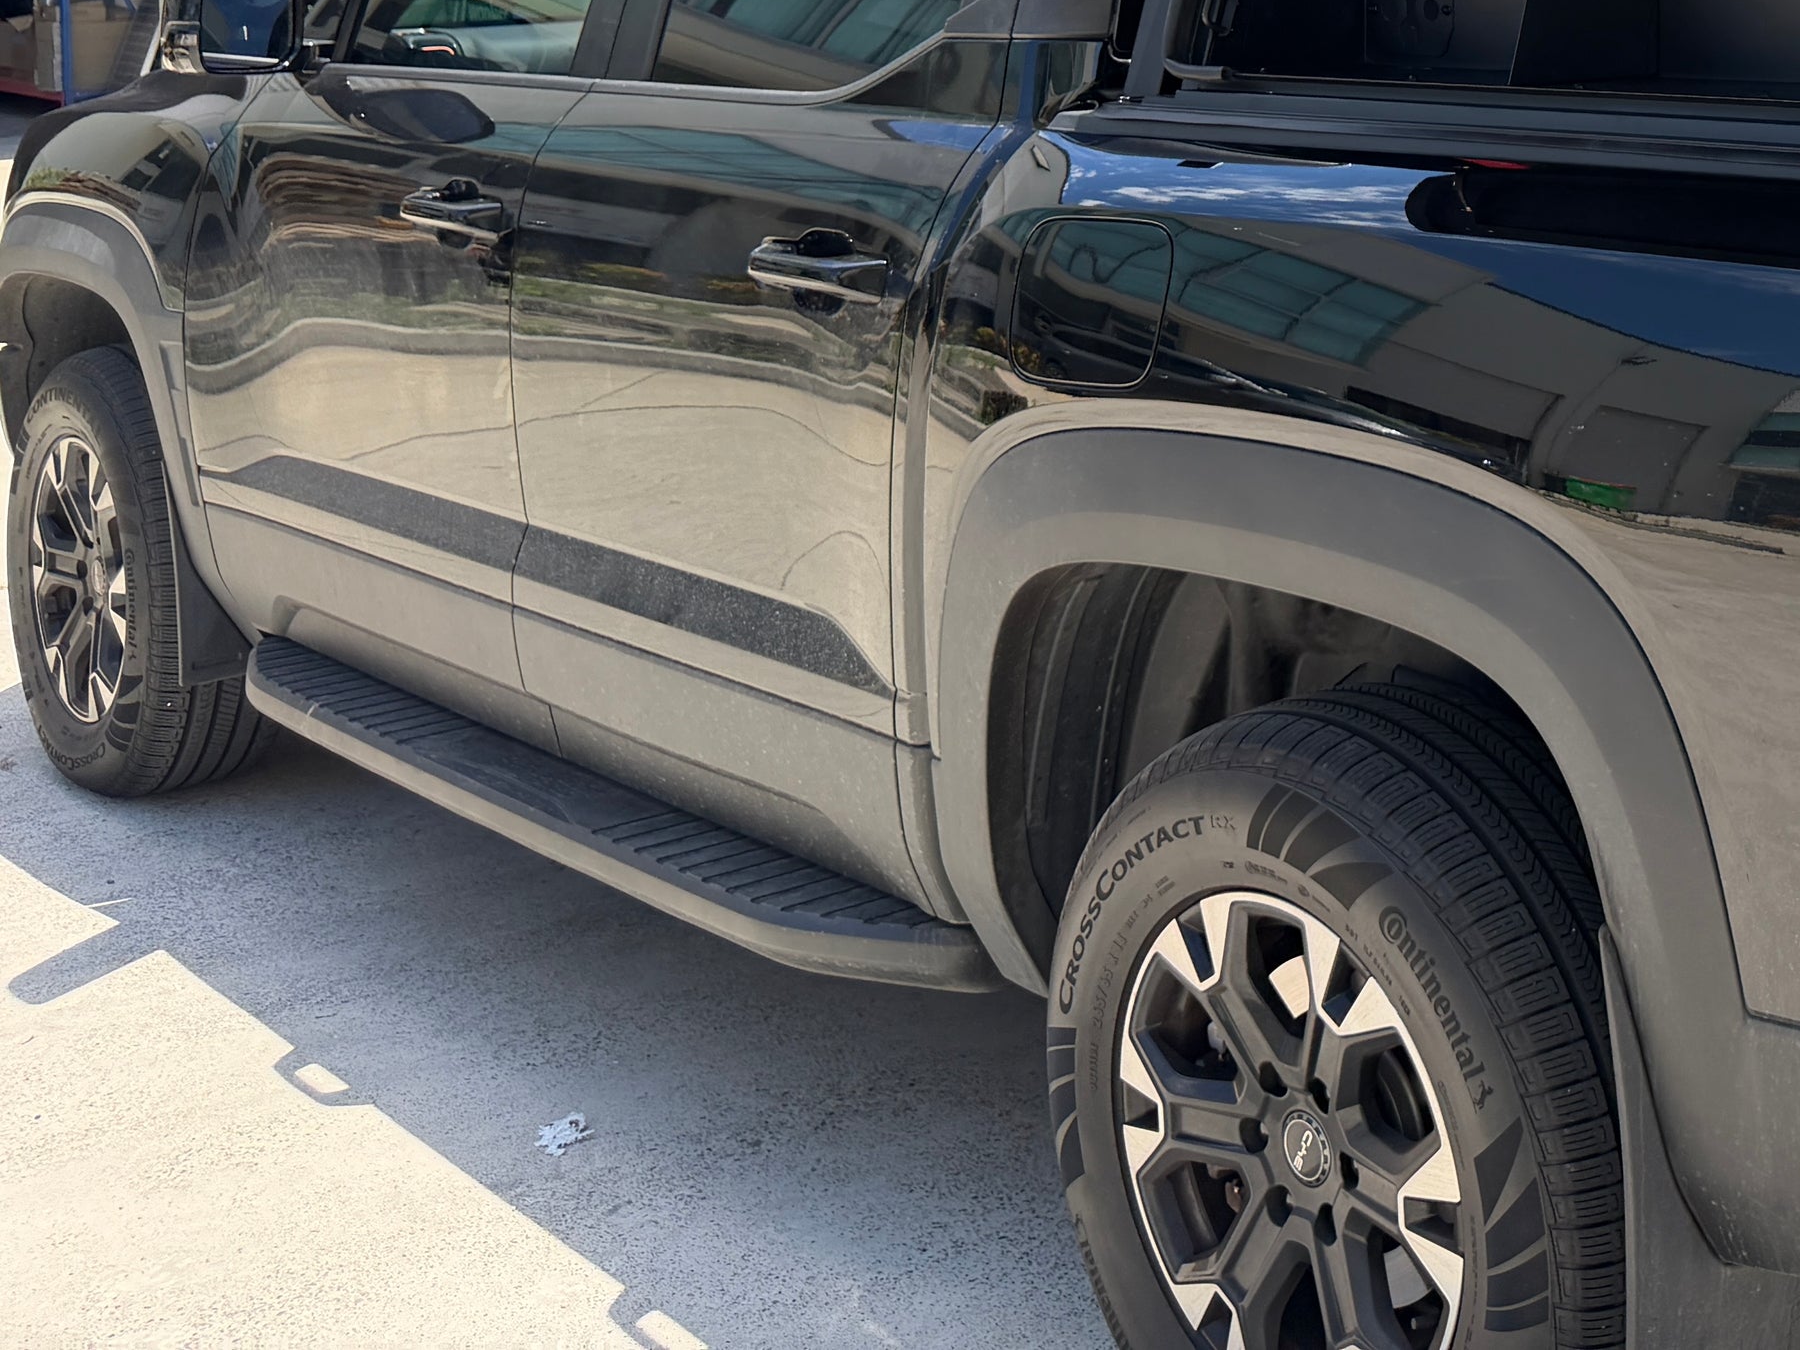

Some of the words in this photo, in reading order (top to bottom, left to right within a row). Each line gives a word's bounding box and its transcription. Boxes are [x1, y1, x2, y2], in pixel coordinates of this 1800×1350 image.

[124, 548, 137, 649] Continental
[1210, 814, 1236, 831] RX
[1378, 905, 1486, 1083] Continental
[1293, 1129, 1313, 1171] BYD
